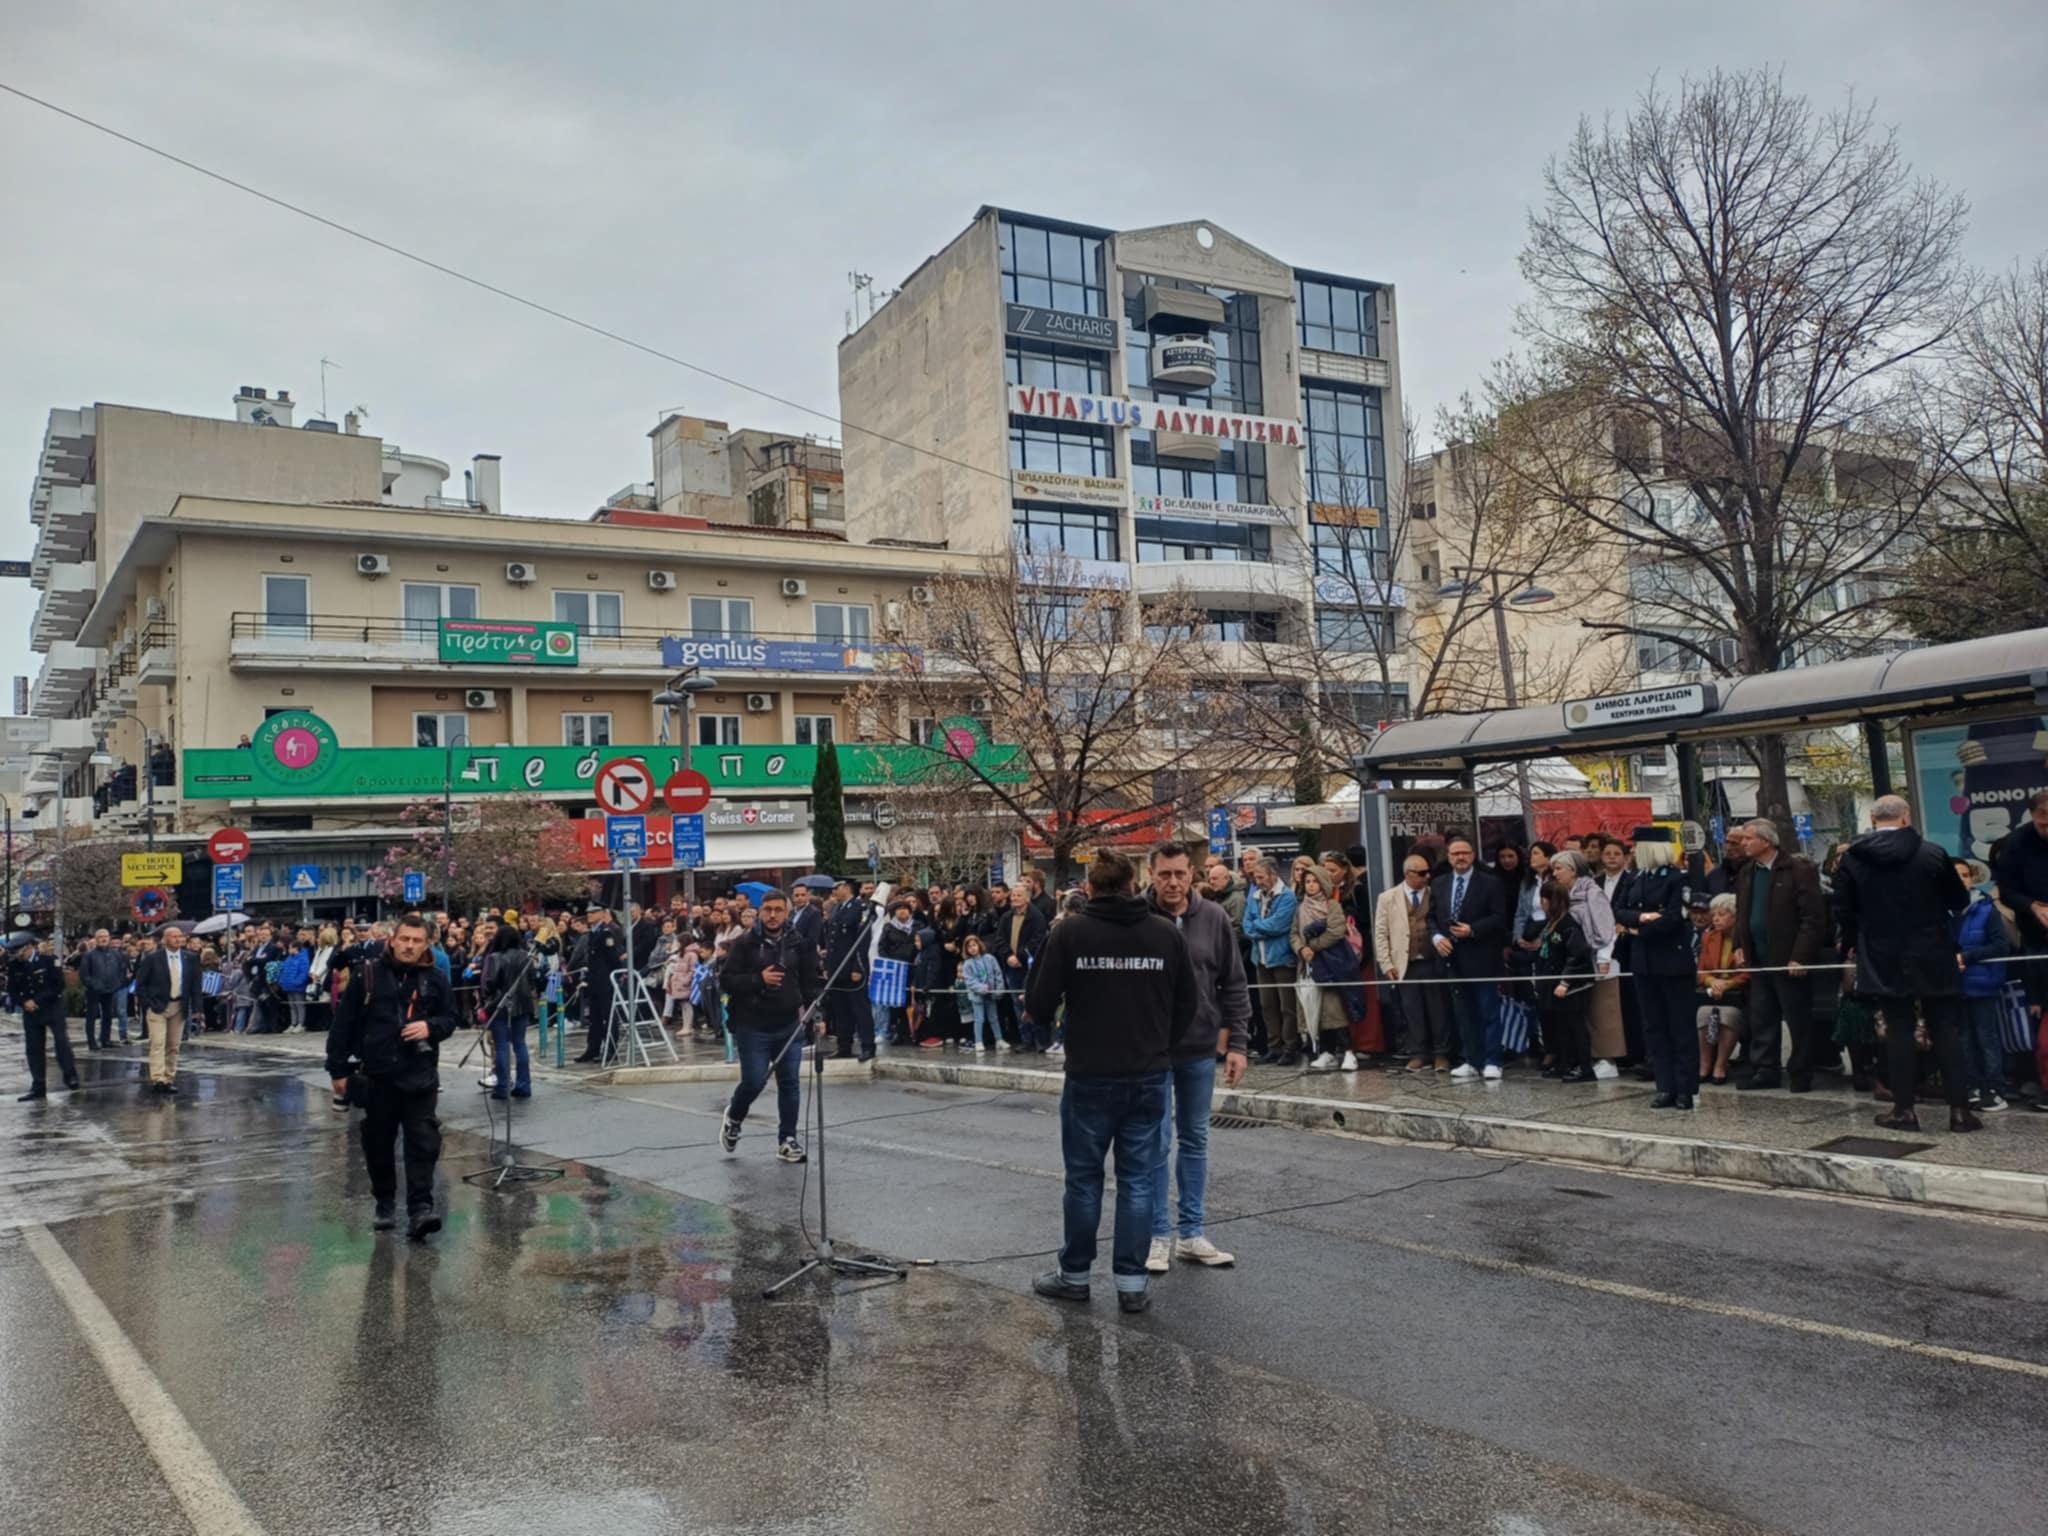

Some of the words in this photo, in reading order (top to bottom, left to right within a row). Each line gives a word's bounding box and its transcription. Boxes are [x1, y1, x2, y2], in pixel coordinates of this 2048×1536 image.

[1045, 313, 1112, 337] ZACHARIS
[1155, 410, 1298, 445] ΑΔΥΝΑΤΙΣΜΑ
[681, 641, 767, 665] genius
[1594, 698, 1632, 711] ΔΗΜΟΣ
[1633, 689, 1692, 706] ΛΑΡΙΣΑΙΩΝ
[1611, 708, 1645, 719] ΚΕΝΤΡΙΚΗ
[1646, 704, 1677, 715] ΠΛΑΤΕΙΑ
[710, 812, 741, 825] Swiss
[760, 811, 795, 824] Corner
[1076, 957, 1164, 970] ALLEN&HEATH
